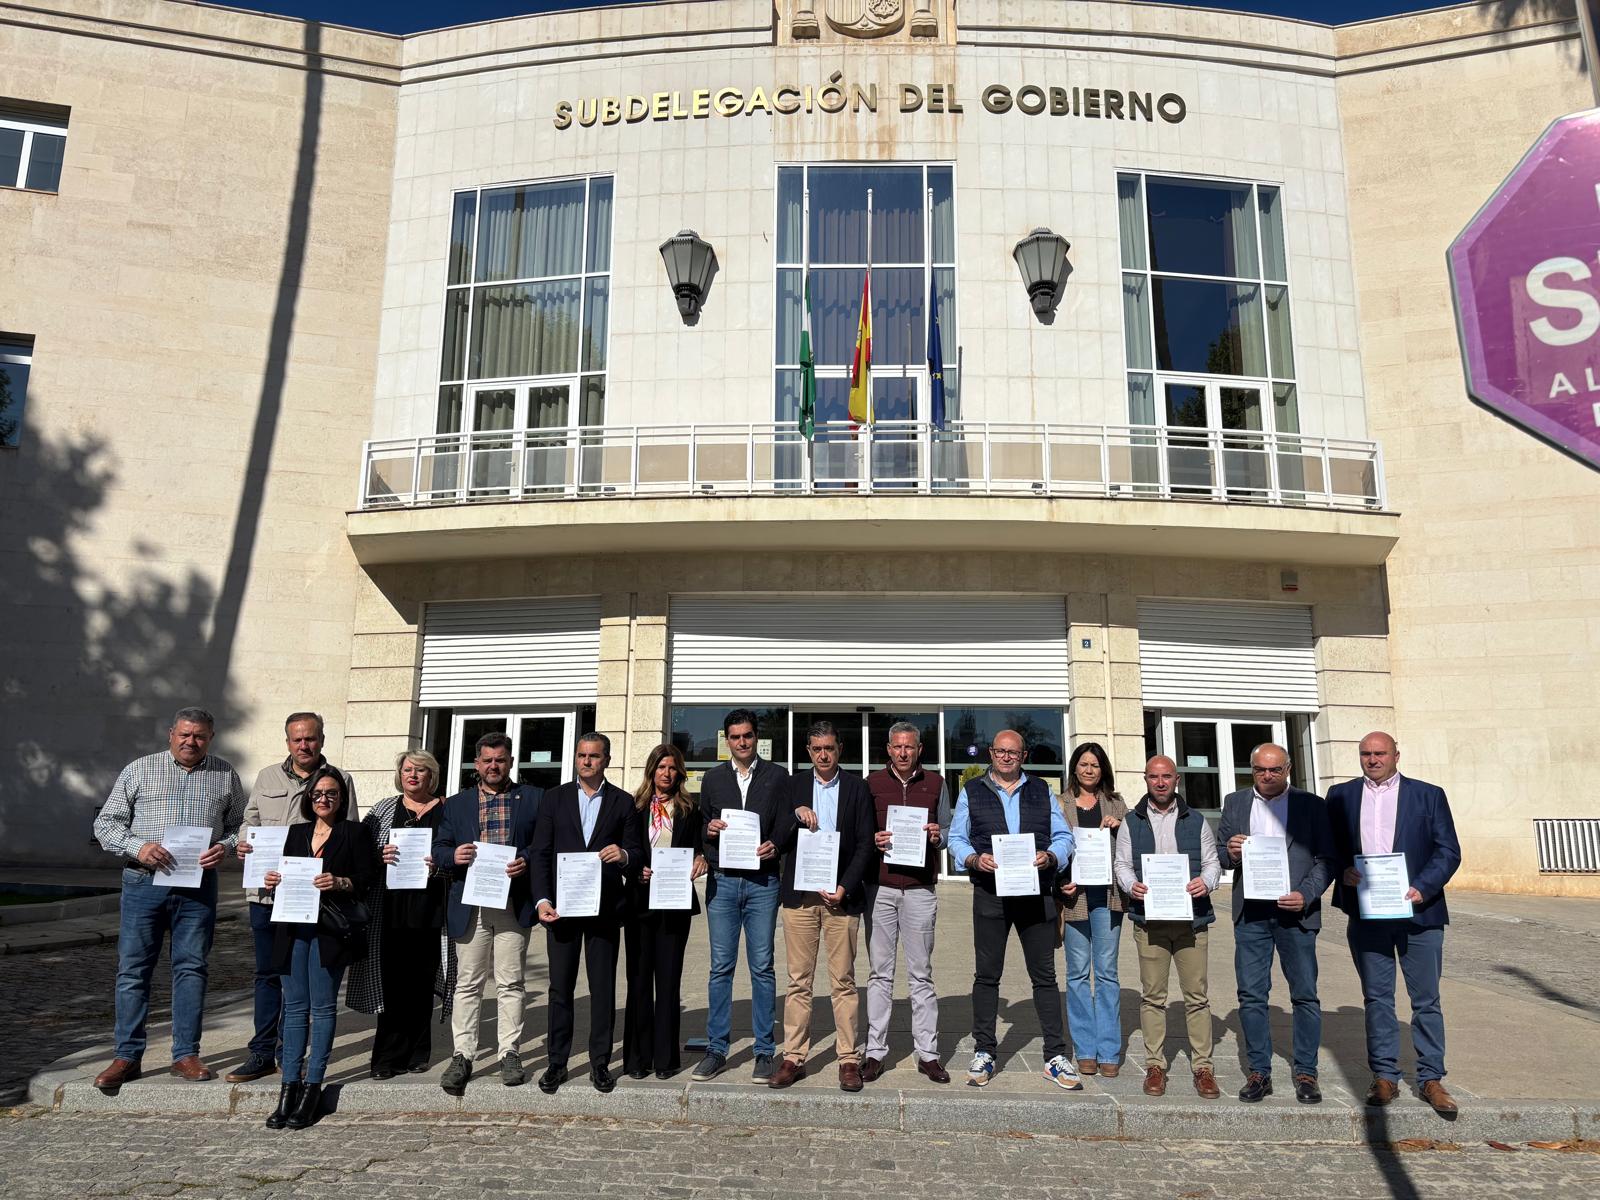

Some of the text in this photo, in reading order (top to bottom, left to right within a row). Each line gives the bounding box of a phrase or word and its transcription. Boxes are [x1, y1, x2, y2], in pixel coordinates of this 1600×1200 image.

[552, 70, 1187, 130] SUBDELEGACIÓN DEL GOBIERNO
